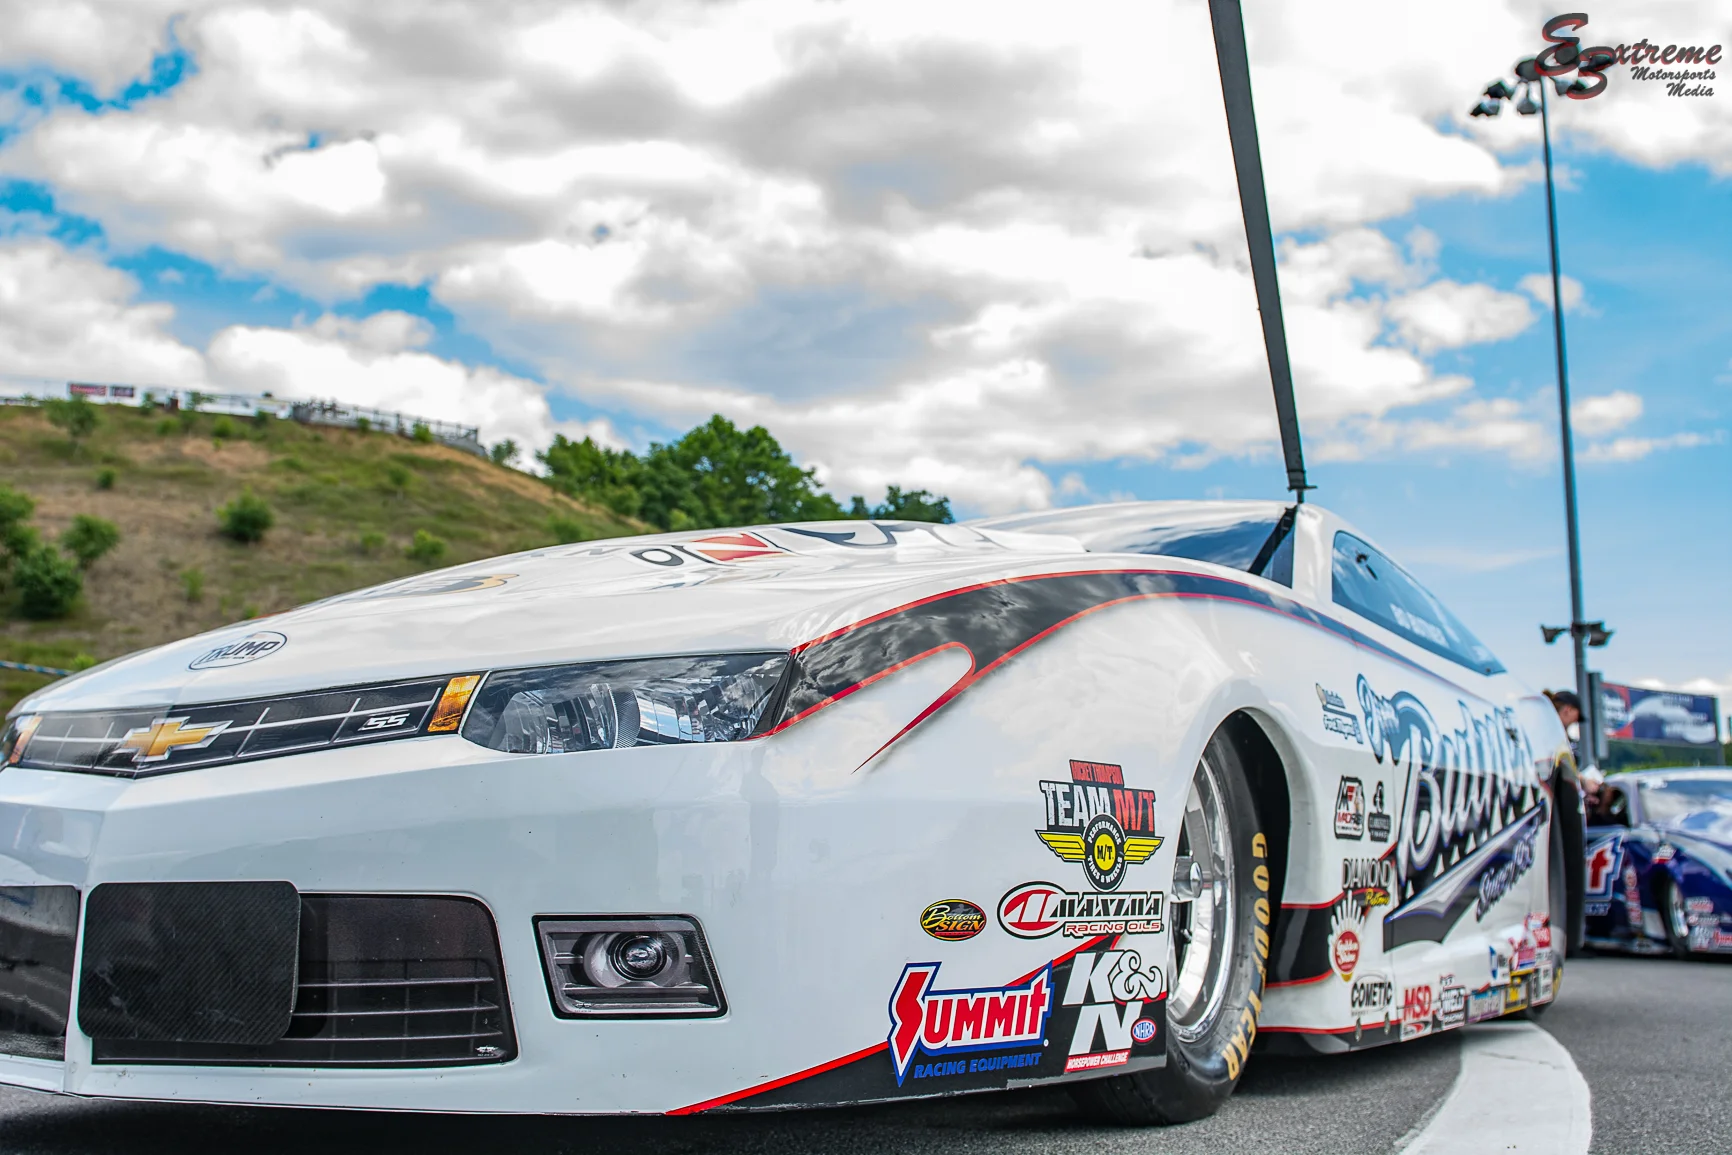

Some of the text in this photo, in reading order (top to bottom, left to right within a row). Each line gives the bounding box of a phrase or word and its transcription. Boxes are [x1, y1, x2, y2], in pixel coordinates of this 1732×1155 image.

[194, 641, 280, 666] TRUMP
[358, 713, 410, 731] SS
[1040, 782, 1155, 832] TEAM M/T
[1087, 820, 1122, 845] PERFORMANCE
[1088, 854, 1104, 880] TIRES
[1105, 856, 1123, 883] WHEELS
[1342, 857, 1392, 890] DIAMOND
[1127, 920, 1161, 933] OILS
[1351, 981, 1393, 1008] COMETIC
[1403, 985, 1432, 1022] MSD
[1133, 1021, 1156, 1039] NHRA
[914, 1052, 1043, 1079] RACING EQUIPMENT
[1066, 1051, 1128, 1069] HORSEPOWER CHALLENGE
